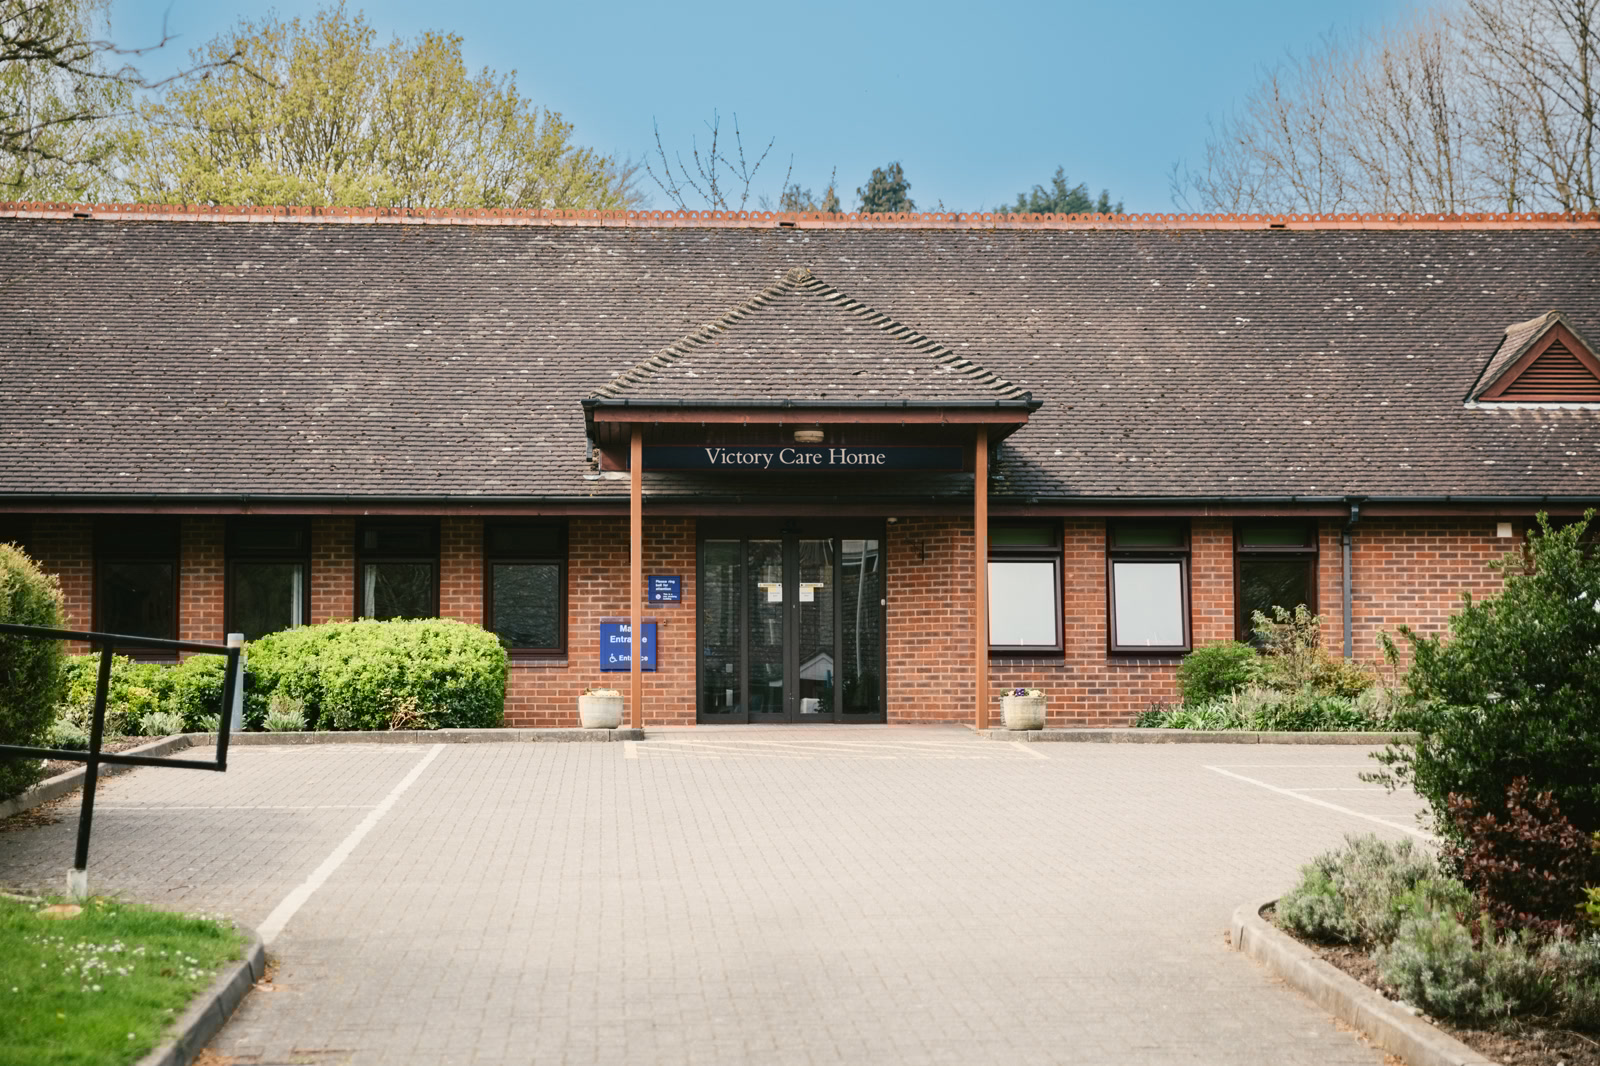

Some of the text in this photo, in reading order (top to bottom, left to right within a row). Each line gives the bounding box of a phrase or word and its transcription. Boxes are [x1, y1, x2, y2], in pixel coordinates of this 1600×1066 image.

[705, 448, 886, 469] Victory Care Home
[609, 635, 648, 643] Entrae
